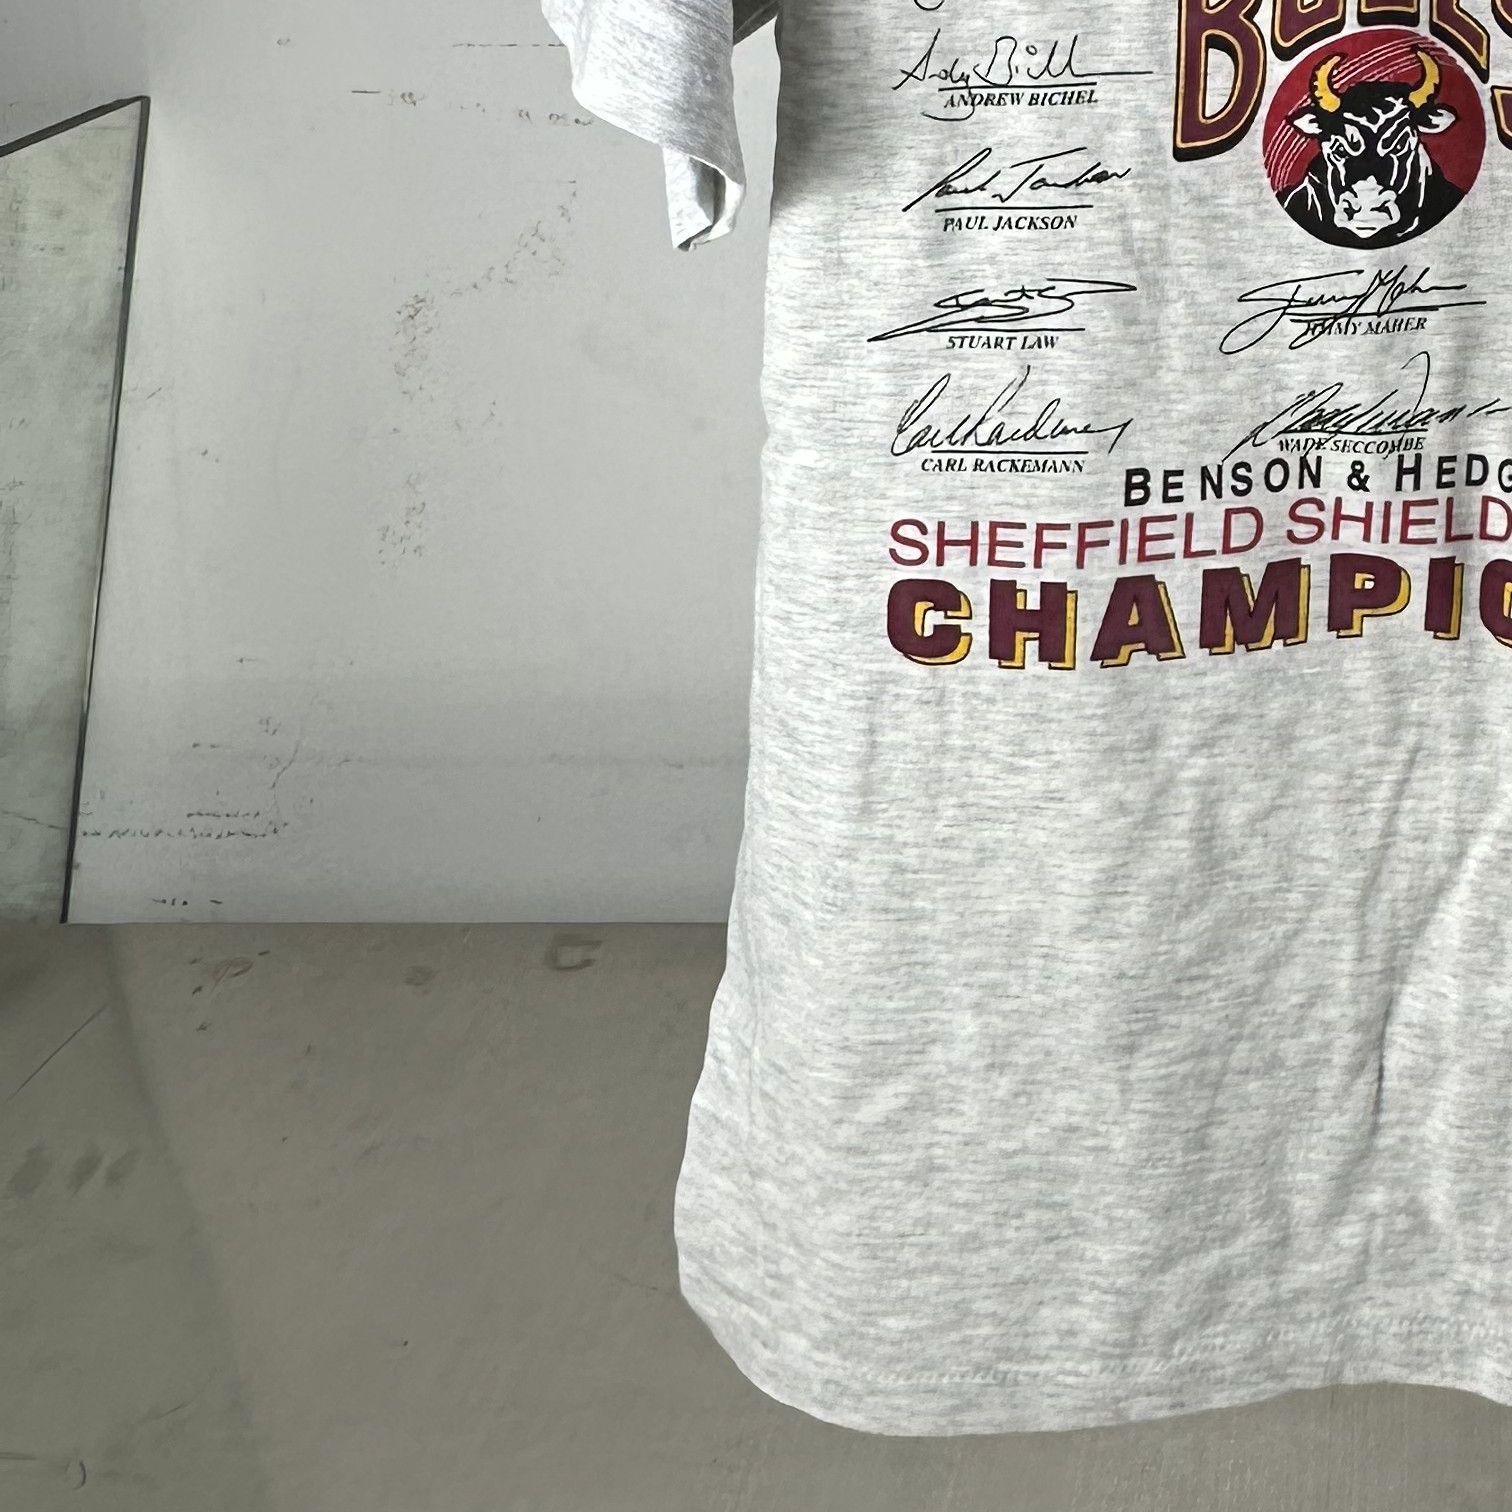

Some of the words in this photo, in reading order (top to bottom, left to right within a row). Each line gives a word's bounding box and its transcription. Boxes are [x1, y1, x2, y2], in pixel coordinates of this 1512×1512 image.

[944, 92, 1023, 109] ANDREW
[1028, 90, 1099, 107] BICHEL
[943, 215, 988, 233] PAUL
[992, 214, 1078, 231] JACKSON
[1361, 317, 1428, 336] MAHER
[946, 335, 1016, 350] STUART
[1021, 335, 1060, 350] LAW
[1278, 437, 1326, 453] WADE
[921, 458, 967, 474] CARL
[972, 458, 1086, 474] RACKEMANN
[1125, 455, 1322, 506] BENSON
[1347, 460, 1370, 492] &
[888, 505, 1265, 569] SHEFFIELD
